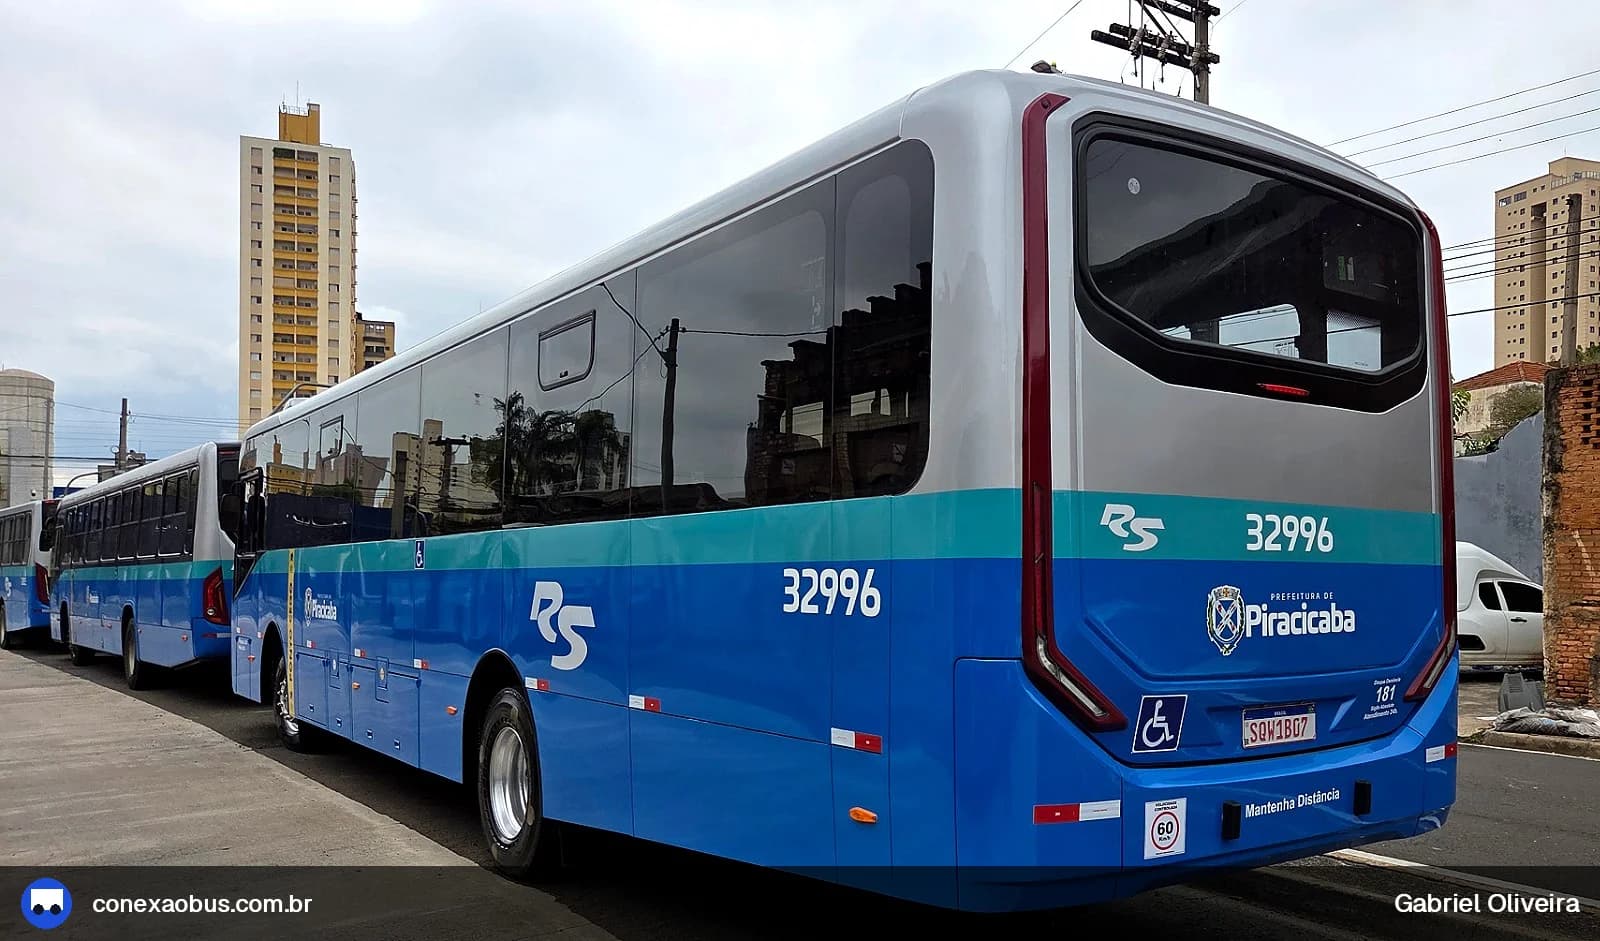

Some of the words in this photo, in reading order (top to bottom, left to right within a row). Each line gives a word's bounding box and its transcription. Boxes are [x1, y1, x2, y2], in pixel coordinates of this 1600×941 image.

[1100, 504, 1165, 551] RS
[1246, 513, 1334, 552] 32996
[783, 568, 881, 617] 32996
[1270, 592, 1321, 601] PREFEITURA
[1324, 591, 1334, 600] DE
[312, 599, 337, 620] Piracicaba
[529, 581, 596, 670] RS
[1245, 602, 1356, 638] Piracicaba
[1376, 684, 1396, 702] 181
[1245, 798, 1295, 818] Mantenha
[1297, 787, 1340, 808] Distância
[1157, 820, 1174, 836] 60
